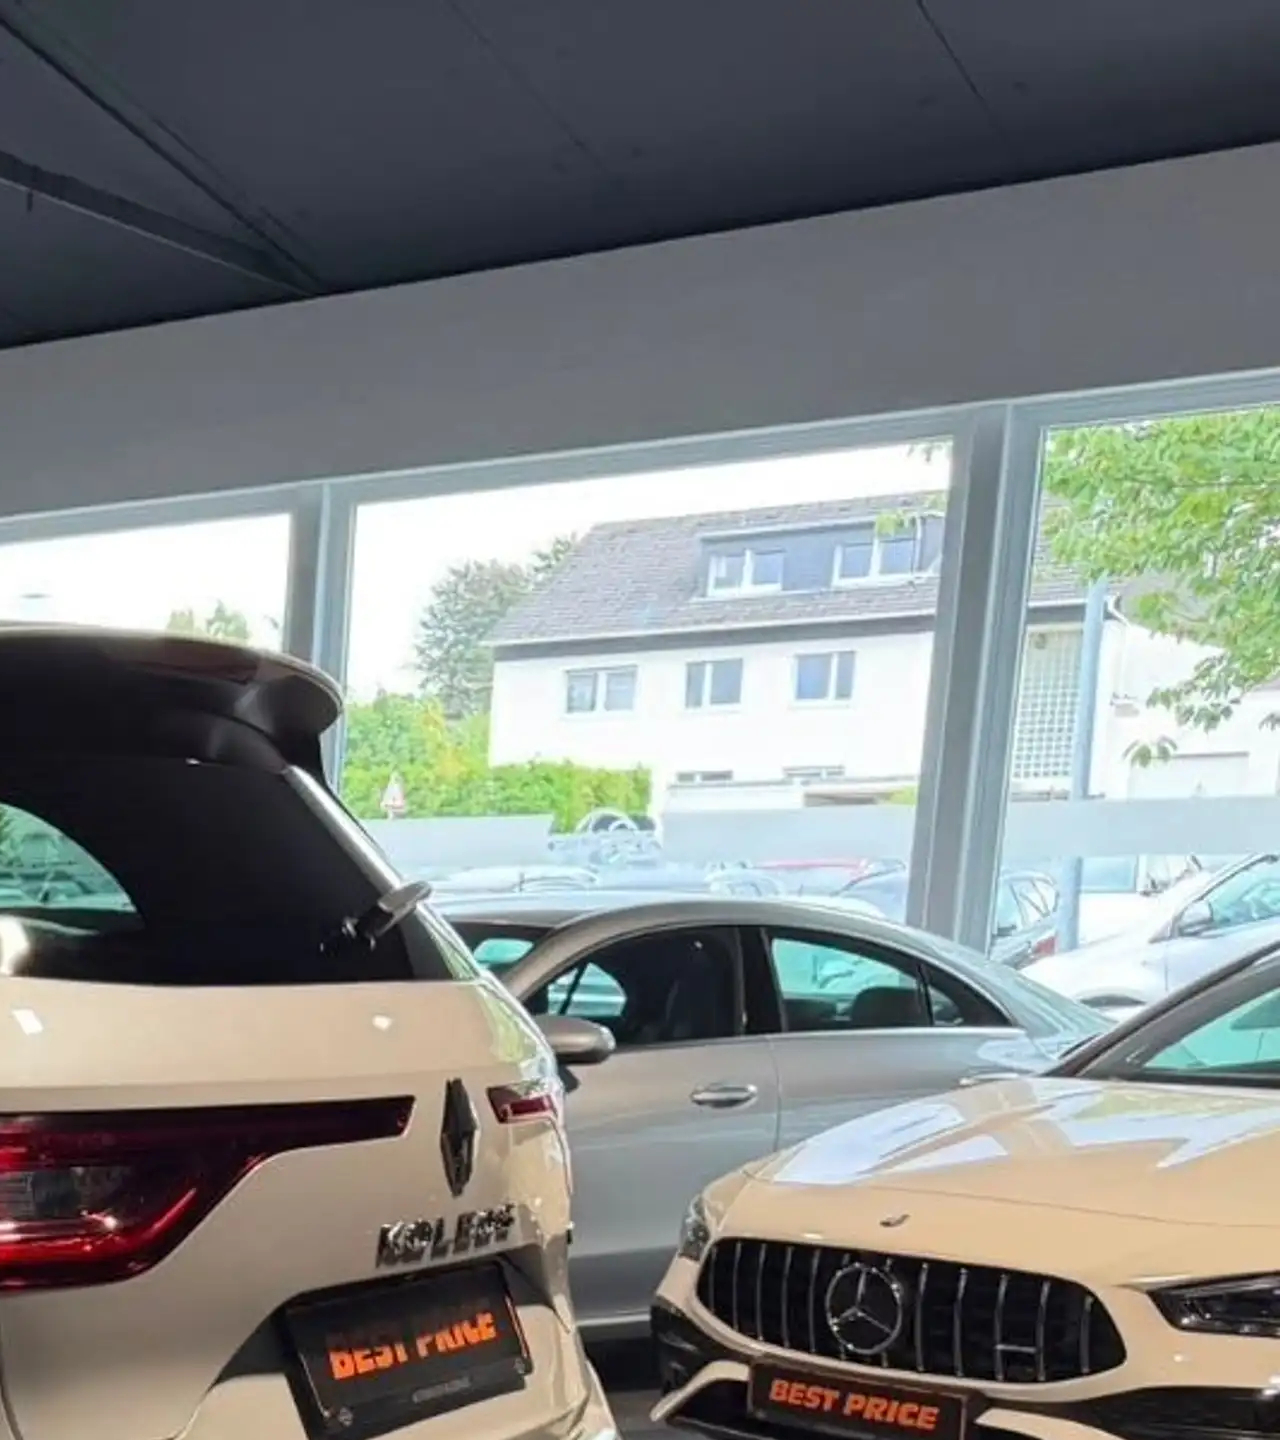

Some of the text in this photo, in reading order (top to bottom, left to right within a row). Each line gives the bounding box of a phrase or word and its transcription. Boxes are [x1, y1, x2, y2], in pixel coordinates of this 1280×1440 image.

[327, 1306, 498, 1381] BEST PRICE
[769, 1378, 940, 1431] BEST PRICE
